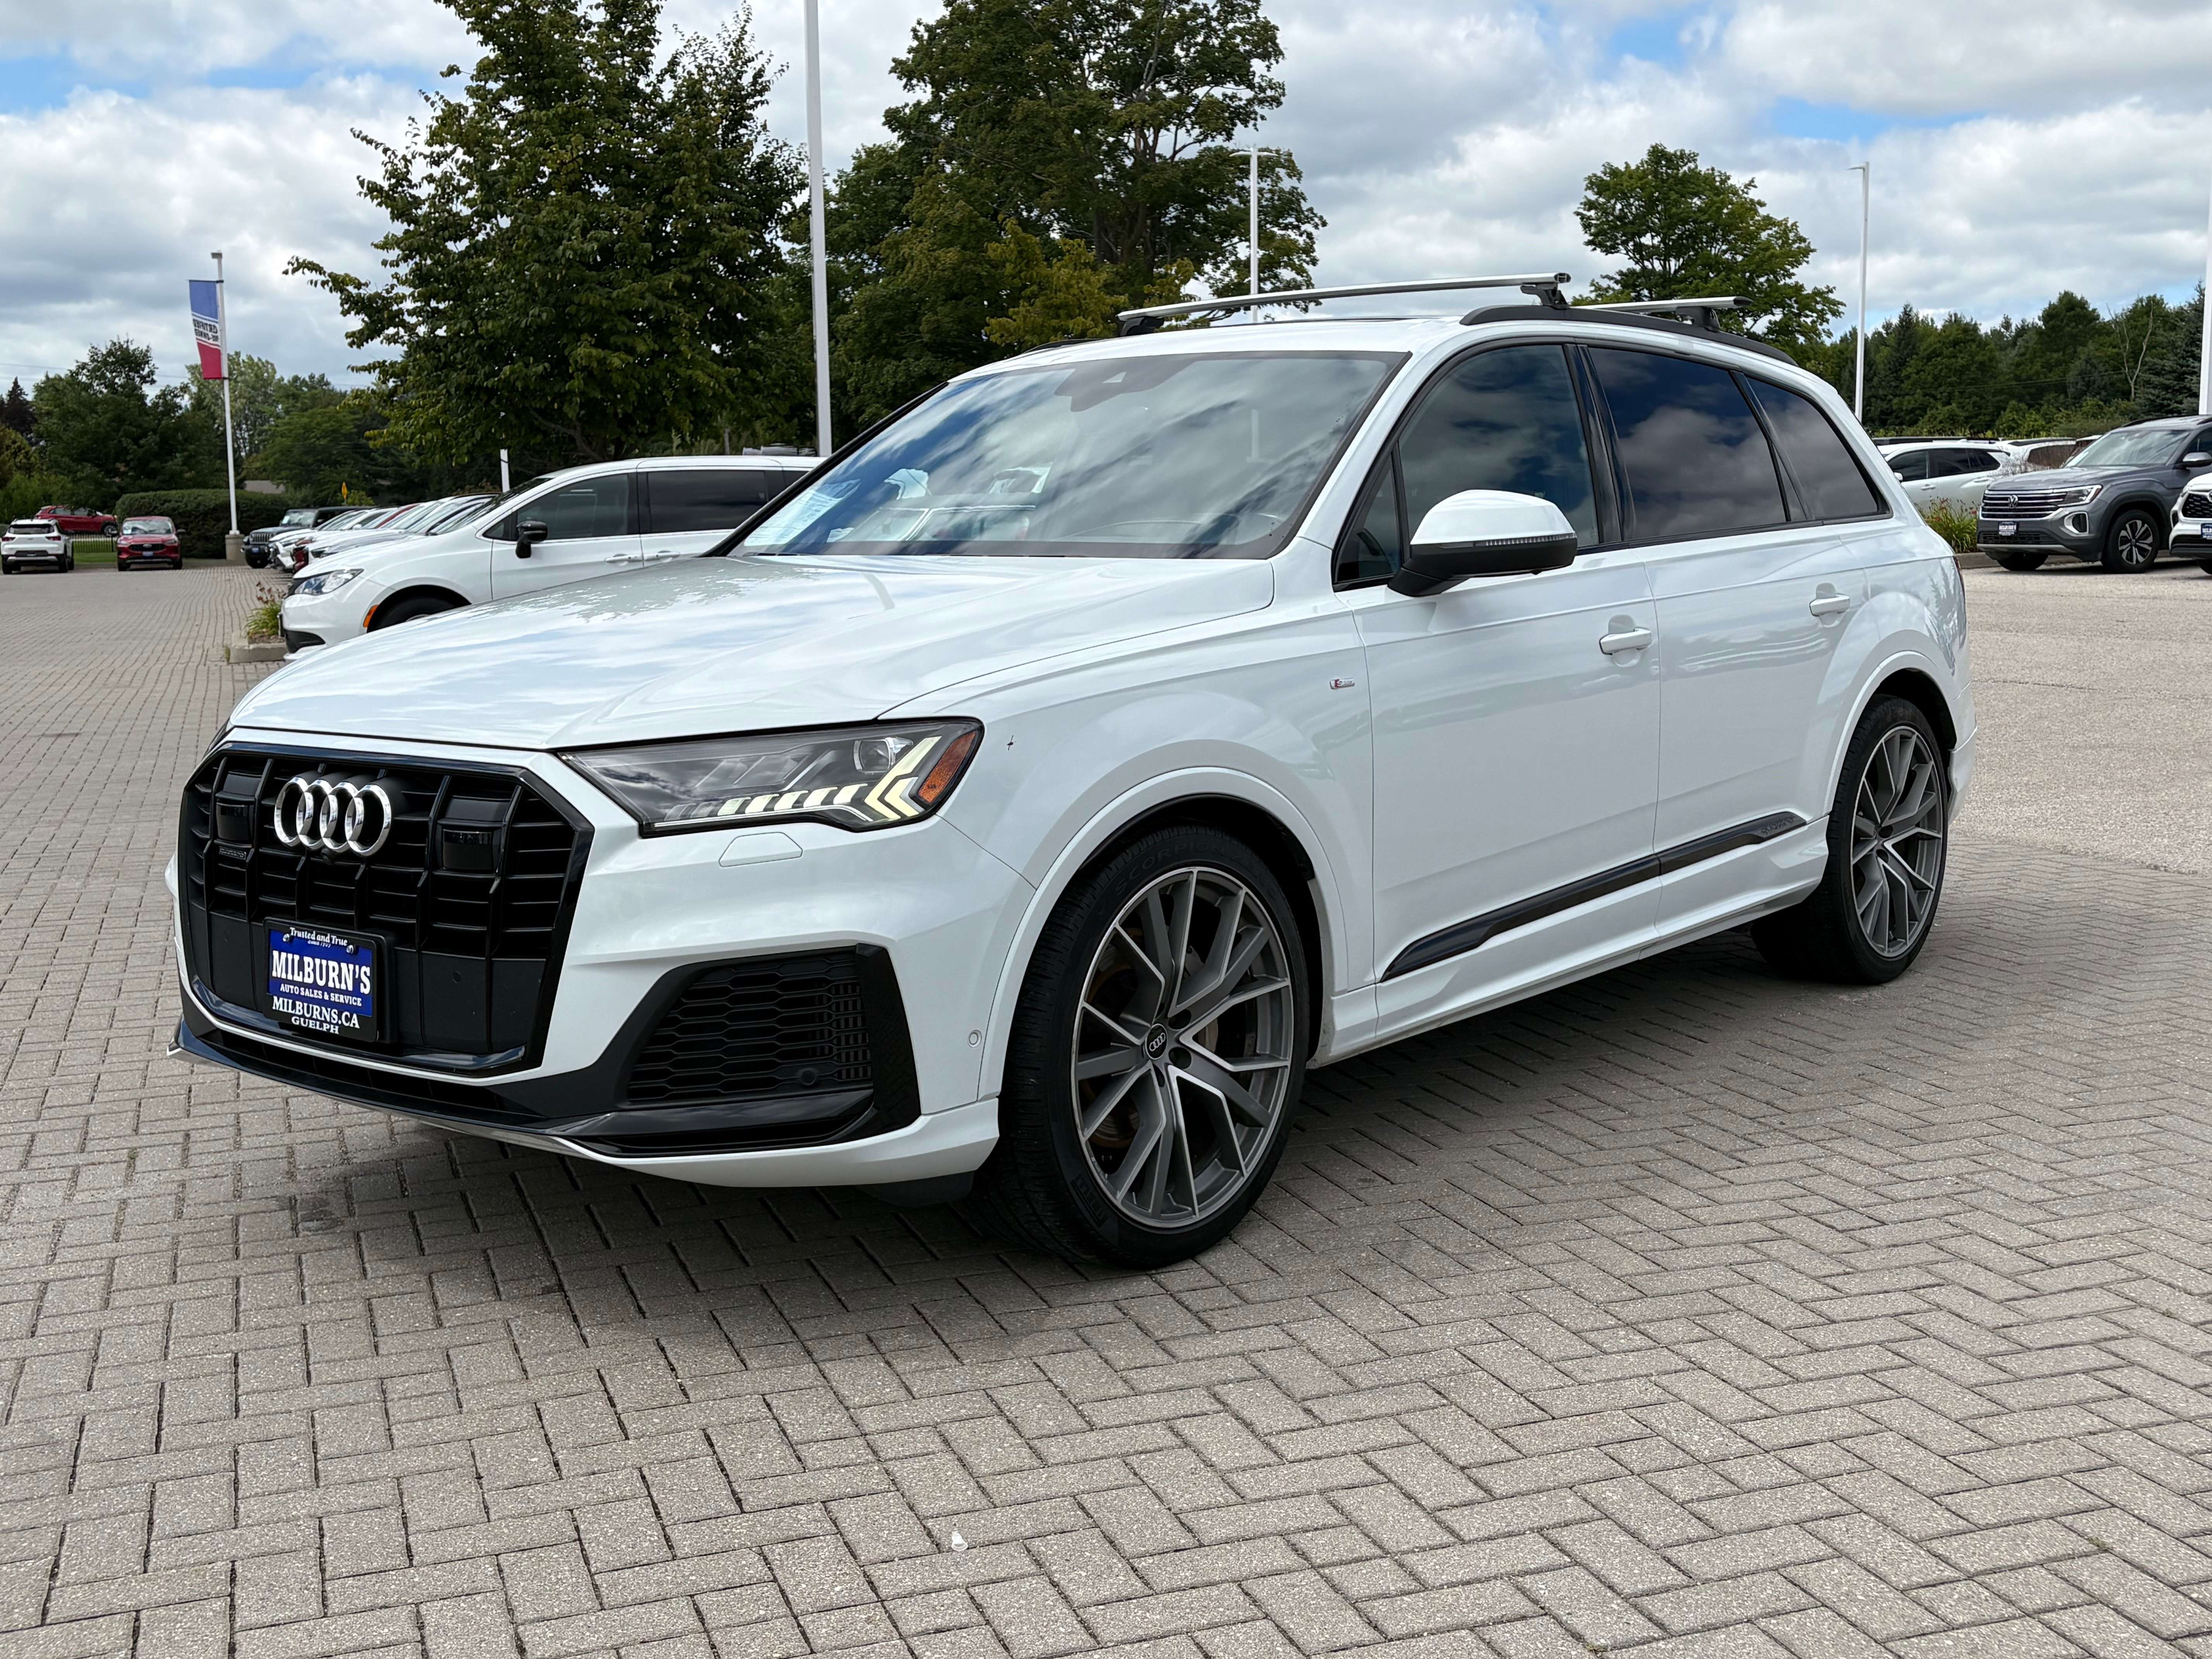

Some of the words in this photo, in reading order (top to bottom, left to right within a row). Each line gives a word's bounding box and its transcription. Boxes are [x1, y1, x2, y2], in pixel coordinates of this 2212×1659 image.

[290, 927, 316, 941] Trusted
[316, 934, 330, 943] and
[331, 935, 347, 946] True
[272, 950, 371, 995] MILBURN'S
[280, 983, 299, 994] AUTO
[300, 987, 322, 999] SALES
[324, 992, 329, 1000] &
[330, 993, 362, 1006] SERVICE
[272, 996, 361, 1029] MILBURNS.CA
[291, 1016, 340, 1035] GUELPH
